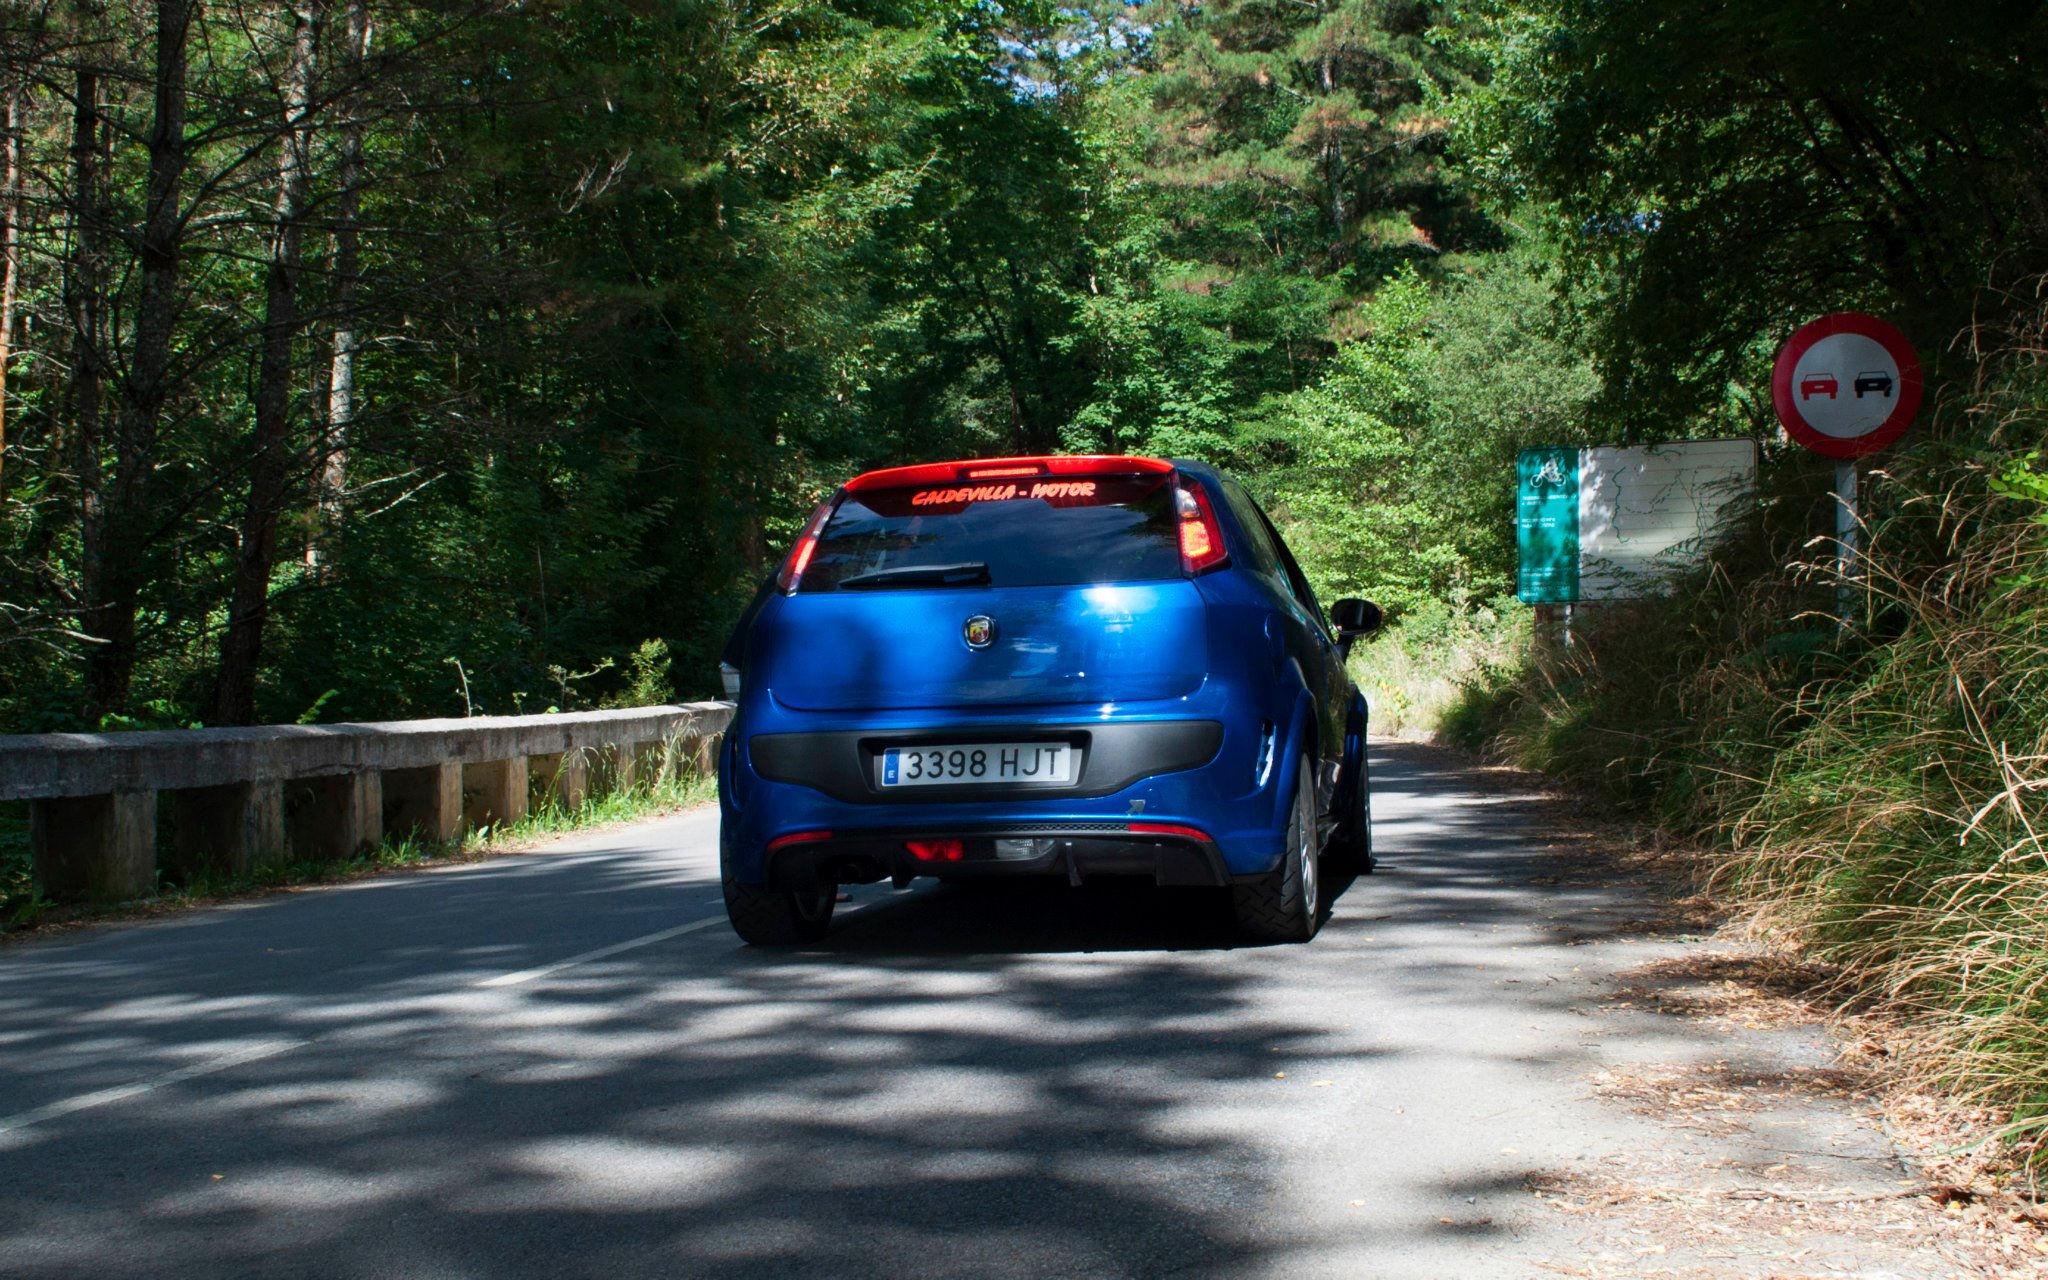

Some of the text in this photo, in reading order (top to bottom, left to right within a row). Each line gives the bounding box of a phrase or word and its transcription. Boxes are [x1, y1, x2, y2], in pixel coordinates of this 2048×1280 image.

[912, 485, 1017, 506] CALDEVILLA
[1031, 482, 1096, 499] MOTOR
[887, 769, 895, 779] E
[906, 748, 1062, 779] 3398 HJT
